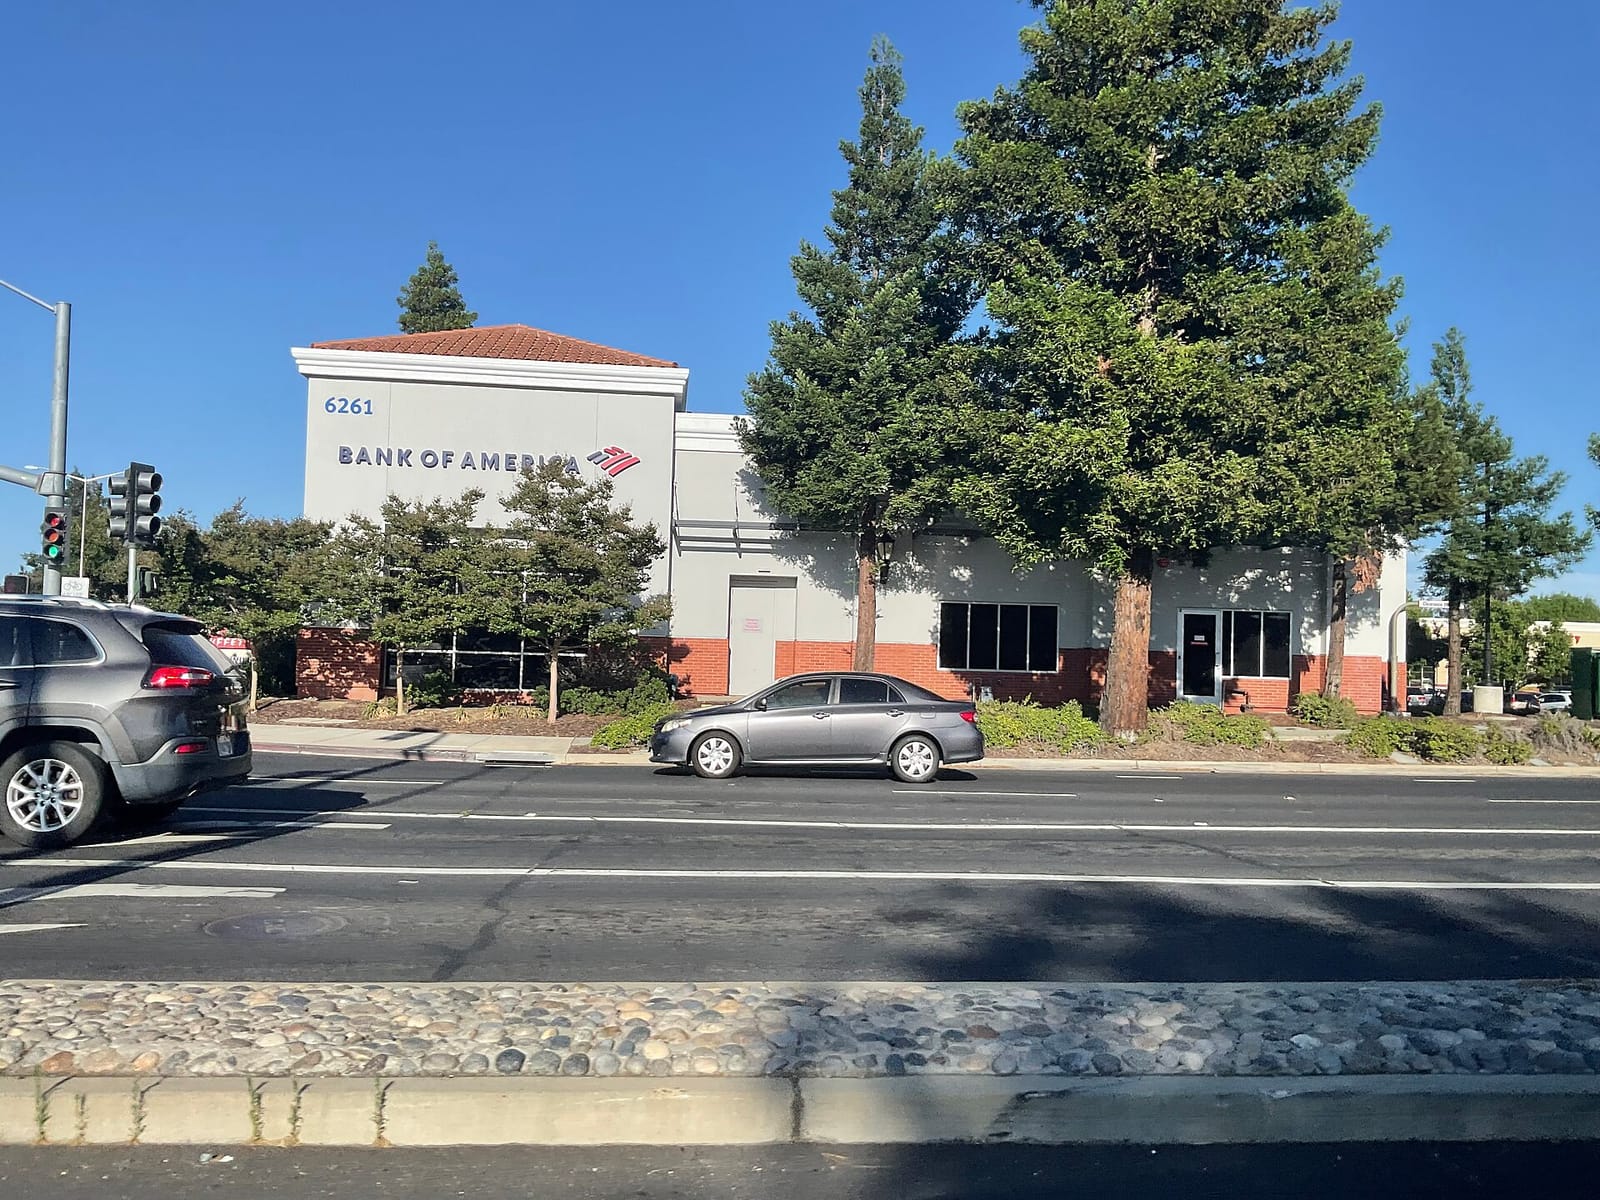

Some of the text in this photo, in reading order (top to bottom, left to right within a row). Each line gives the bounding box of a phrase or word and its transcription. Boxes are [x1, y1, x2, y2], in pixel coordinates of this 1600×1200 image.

[325, 397, 373, 415] 6261
[339, 445, 412, 467] BANK
[420, 449, 455, 469] OF
